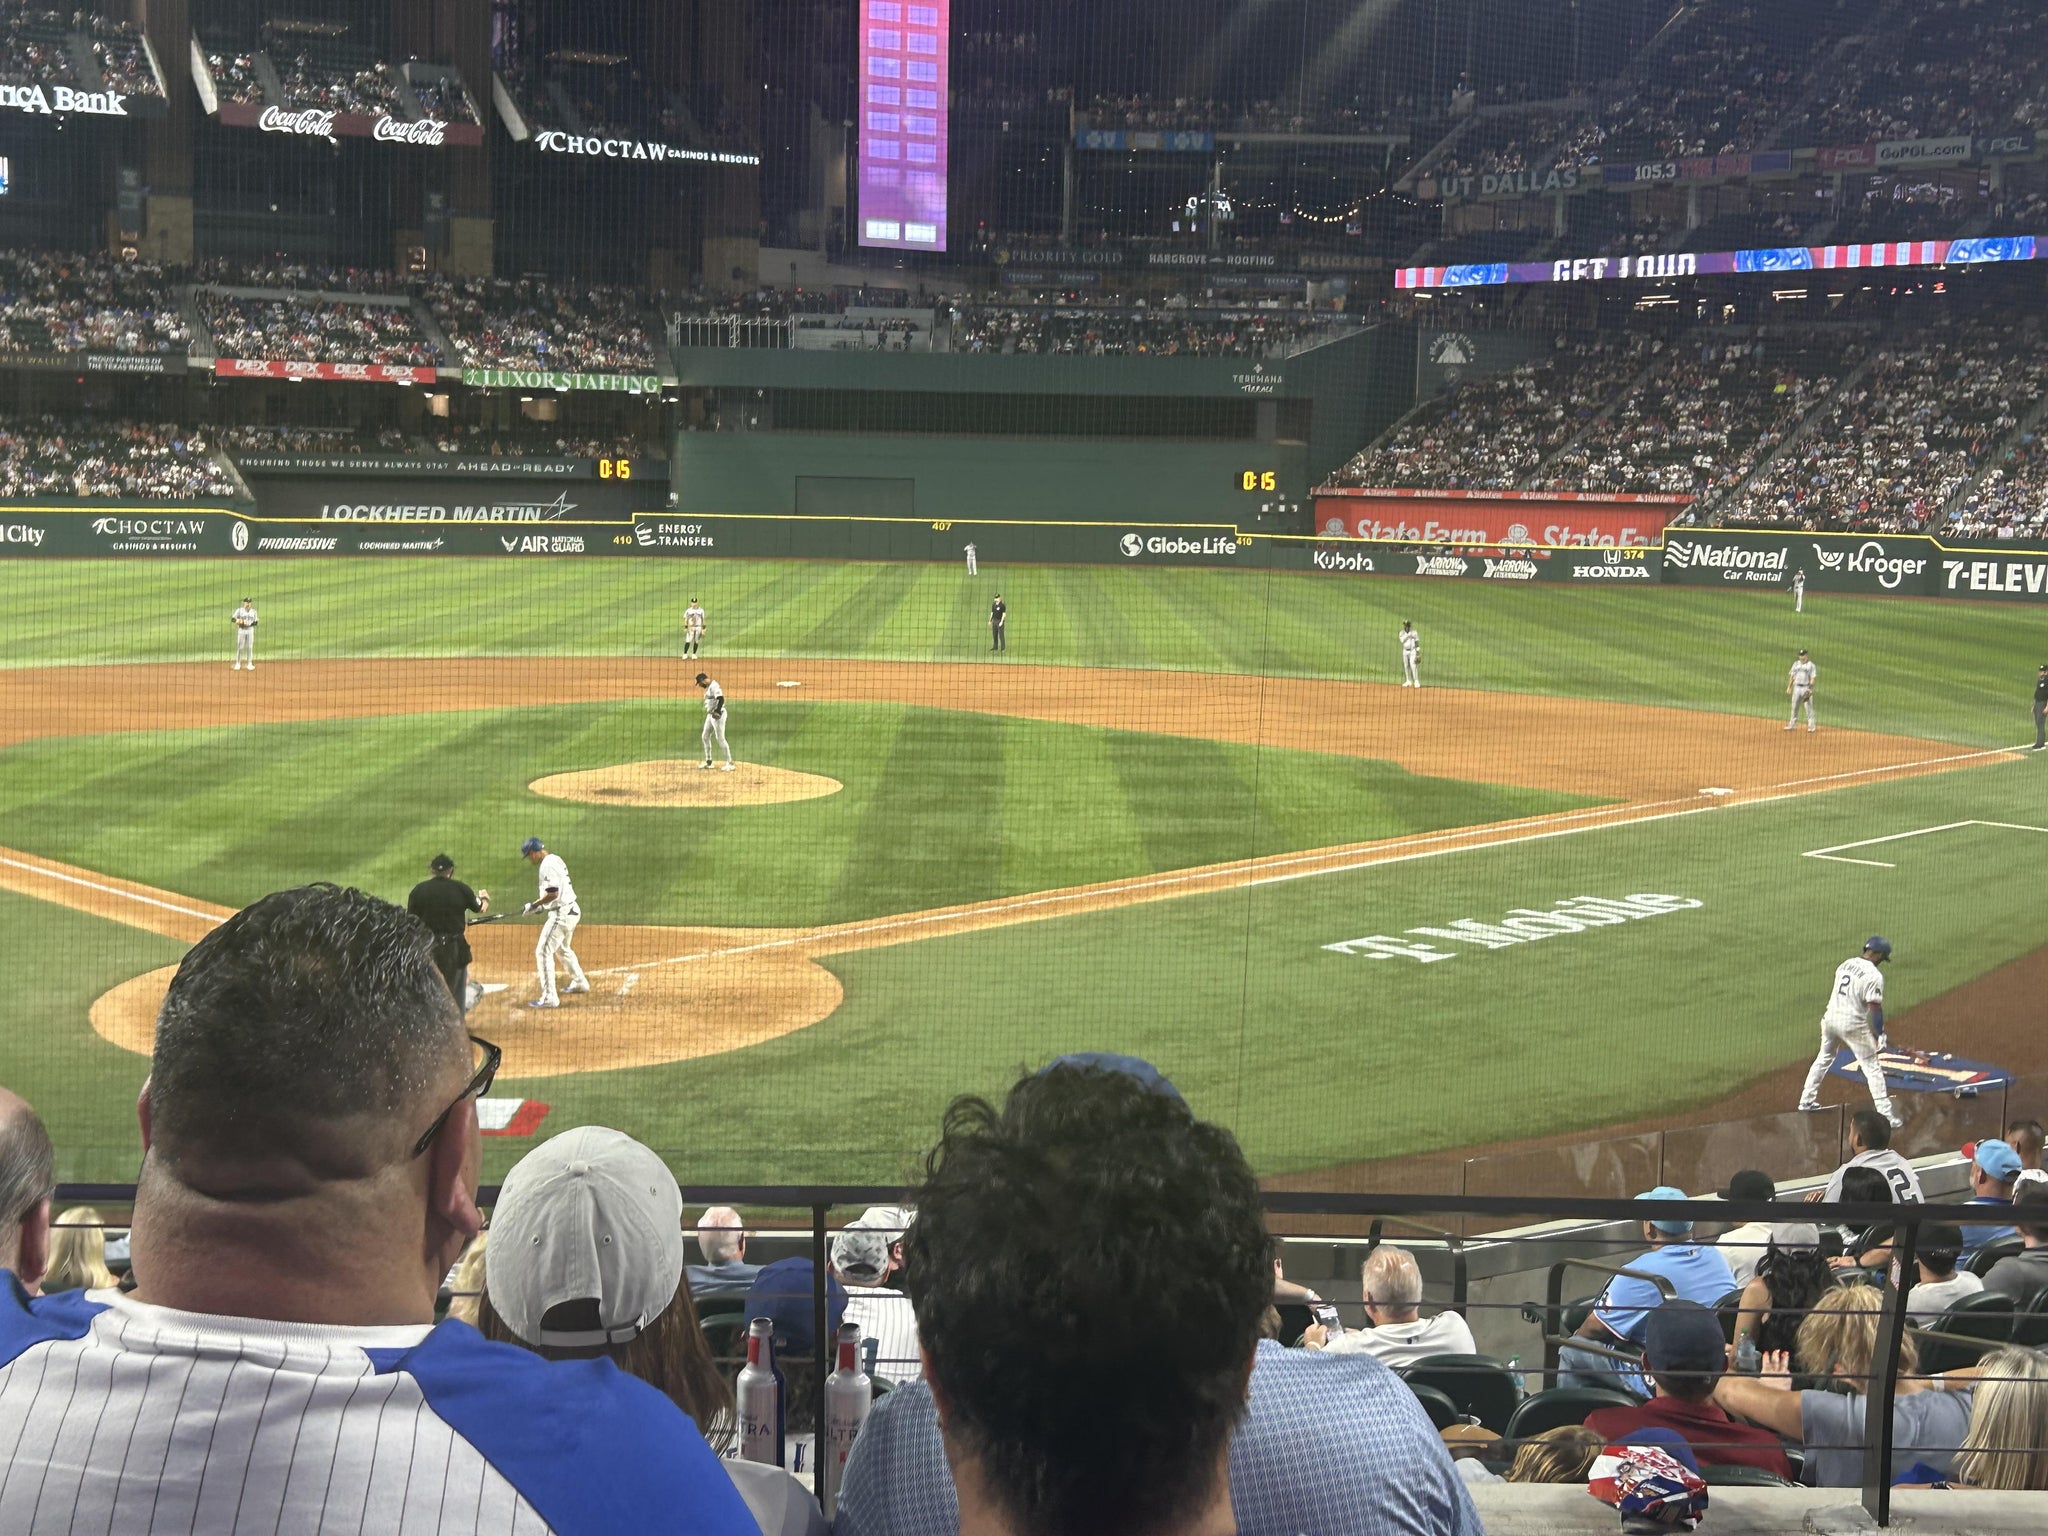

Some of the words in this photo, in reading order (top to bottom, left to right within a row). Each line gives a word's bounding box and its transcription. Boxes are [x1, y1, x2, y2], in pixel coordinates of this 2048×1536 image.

[53, 86, 128, 115] Bank
[549, 131, 667, 162] CHOCTAW
[668, 149, 709, 160] CASINOS
[711, 152, 717, 162] &
[719, 153, 760, 165] RESORTS
[1635, 163, 1676, 182] 105.3
[1442, 177, 1475, 197] UT
[1482, 168, 1577, 194] DALLAS
[1149, 253, 1207, 265] HARGROVE
[1227, 255, 1275, 266] ROOFING
[235, 360, 270, 371] DEX
[285, 361, 319, 373] DEX
[334, 363, 368, 375] DEX
[381, 365, 415, 377] DEX
[482, 370, 556, 389] LUXOR
[562, 373, 658, 392] STAFFING
[457, 462, 511, 471] AHEAD
[599, 458, 631, 479] 0:15
[1242, 471, 1275, 491] 0:15
[321, 504, 446, 522] LOCKHEED
[453, 505, 542, 522] MARTIN
[103, 517, 205, 535] CHOCTAW
[658, 524, 703, 535] ENERGY
[931, 521, 952, 532] 407
[7, 524, 46, 547] City
[613, 535, 633, 545] 410
[658, 536, 714, 547] TRANSFER
[1236, 537, 1252, 546] 410
[257, 537, 338, 550] PROGRESSIVE
[359, 541, 400, 550] LOCKHEED
[402, 541, 432, 550] MARTIN
[520, 535, 548, 552] AIR
[551, 543, 585, 553] GUARD
[1147, 537, 1201, 555] Globe
[1203, 537, 1236, 555] Life
[1313, 551, 1374, 571] Kubota
[1623, 550, 1645, 560] 374
[1691, 544, 1788, 570] National
[1428, 556, 1462, 569] ARROW
[1495, 559, 1530, 573] ARROW
[1848, 541, 1927, 589] Kroger
[1573, 565, 1650, 579] HONDA
[1723, 569, 1742, 581] Car
[1745, 570, 1782, 582] Rental
[1942, 559, 2048, 594] 7-ELEV
[1838, 974, 1851, 996] 2
